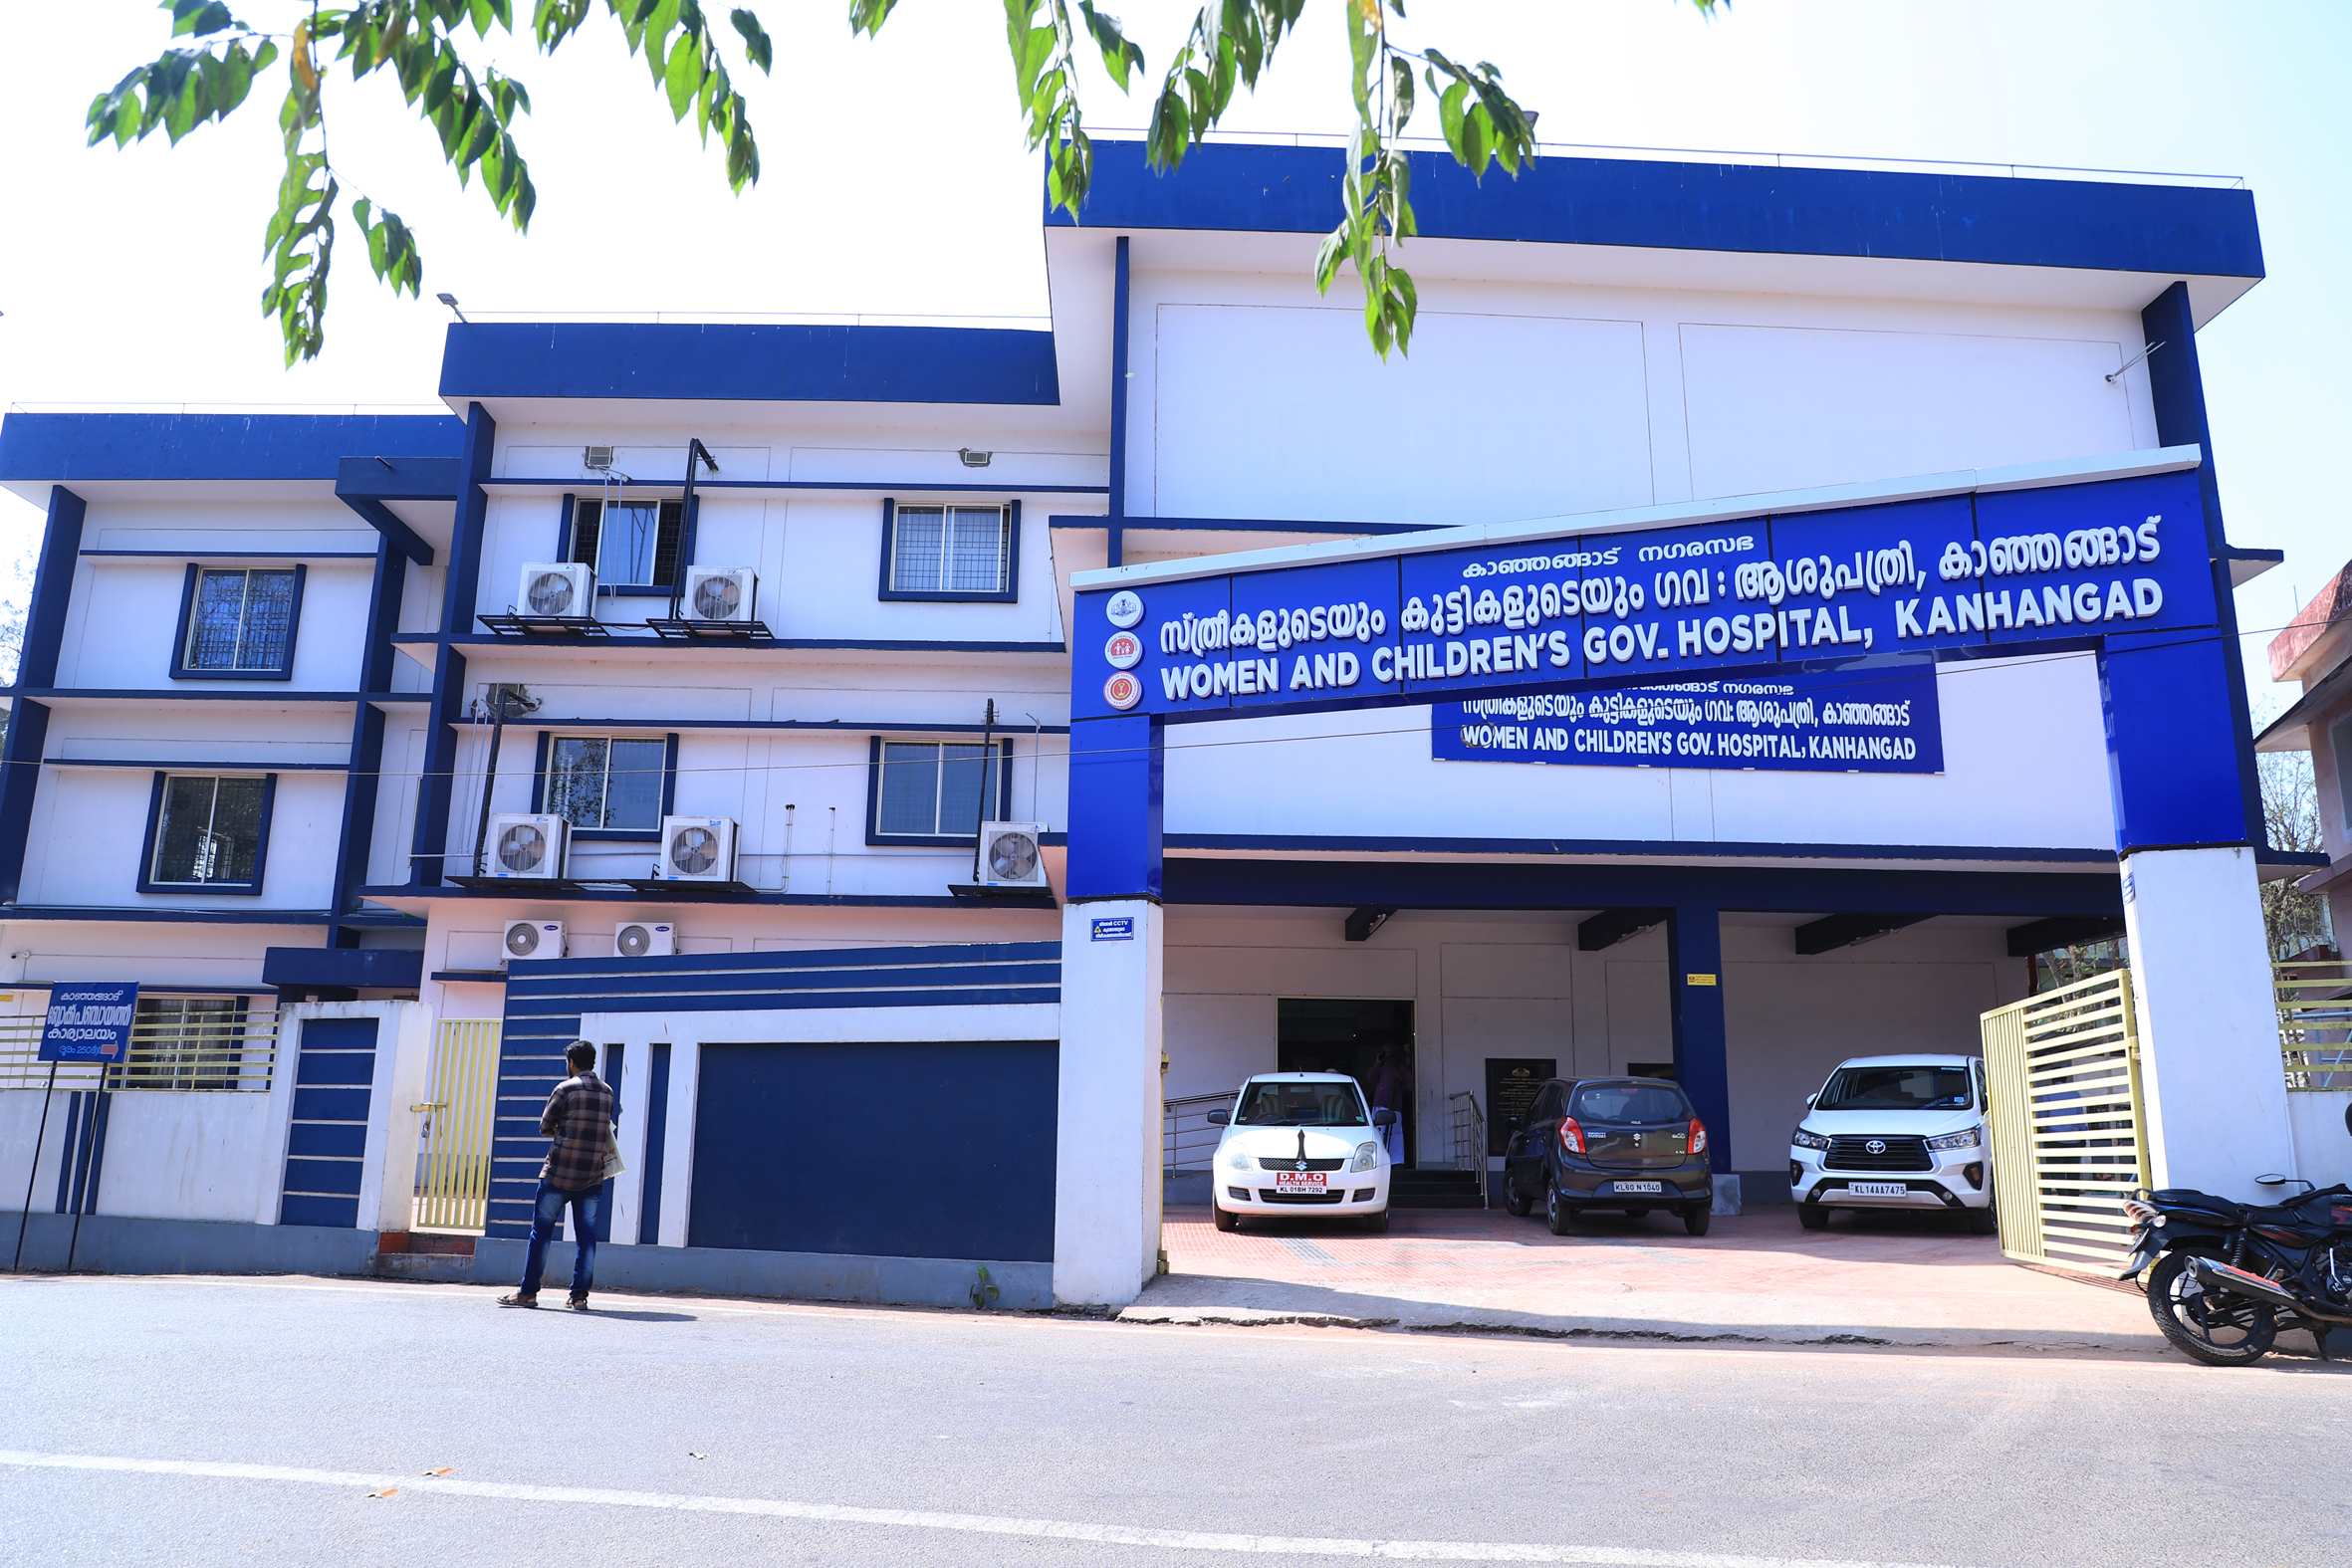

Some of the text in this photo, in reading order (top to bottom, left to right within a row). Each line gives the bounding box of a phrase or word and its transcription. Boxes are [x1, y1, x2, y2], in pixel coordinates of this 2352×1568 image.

[1462, 535, 1755, 578] കാഞ്ഞങ്ങാട് നഗരസഭ
[1160, 601, 1386, 658] സ്ത്രീകളുടെയും
[1401, 575, 1645, 637] കുട്ടികളുടെയും
[1735, 540, 1927, 605] ആശുപത്രി,
[1939, 515, 2162, 581] കാഞ്ഞങ്ങാട്
[1161, 657, 1280, 701] WOMEN
[1290, 651, 1360, 690] AND
[1583, 622, 1669, 664] GOV.
[1678, 605, 1873, 650] HOSPITAL,
[1895, 578, 2163, 638] KANHANGAD
[1723, 683, 1794, 695] നഗരസഭ
[1588, 692, 1702, 726] കുട്ടികളുടെയും
[1737, 697, 1818, 729] ആശുപത്രി,
[1822, 700, 1911, 726] കാഞ്ഞങ്ങാട്
[1463, 725, 1917, 760] WOMEN AND CHILDREN'S GOV. HOSPITAL, KANHANGAD
[48, 1027, 117, 1042] കാര്യാലയം
[1854, 1185, 1905, 1195] KL14AA7475
